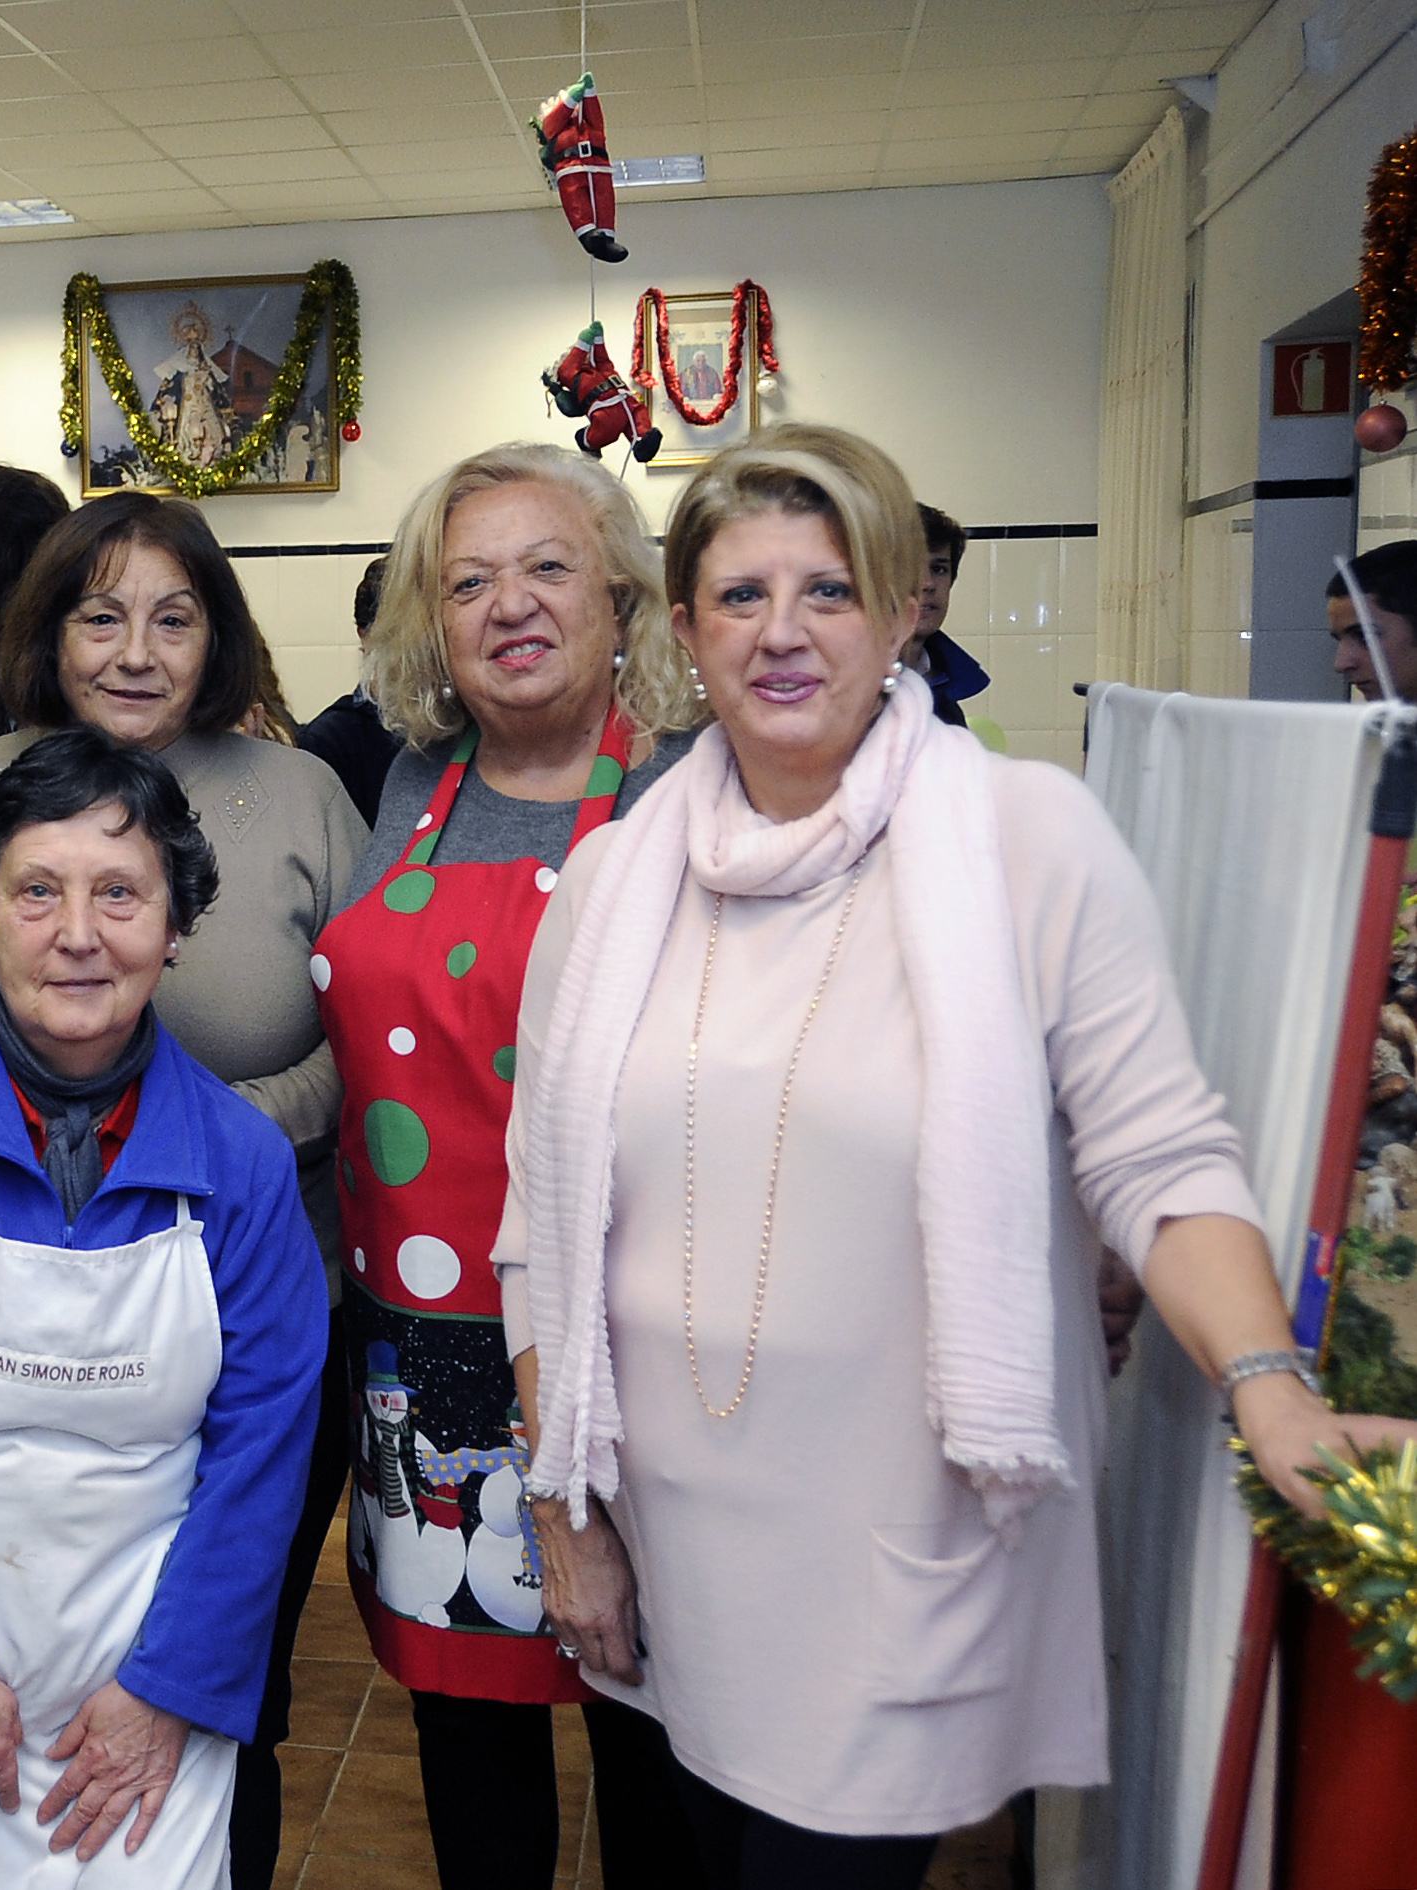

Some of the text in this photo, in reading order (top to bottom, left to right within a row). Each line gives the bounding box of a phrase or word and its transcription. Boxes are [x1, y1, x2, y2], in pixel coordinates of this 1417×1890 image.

[20, 1362, 73, 1383] SIMON
[76, 1366, 96, 1382] DE
[98, 1361, 145, 1382] ROJAS
